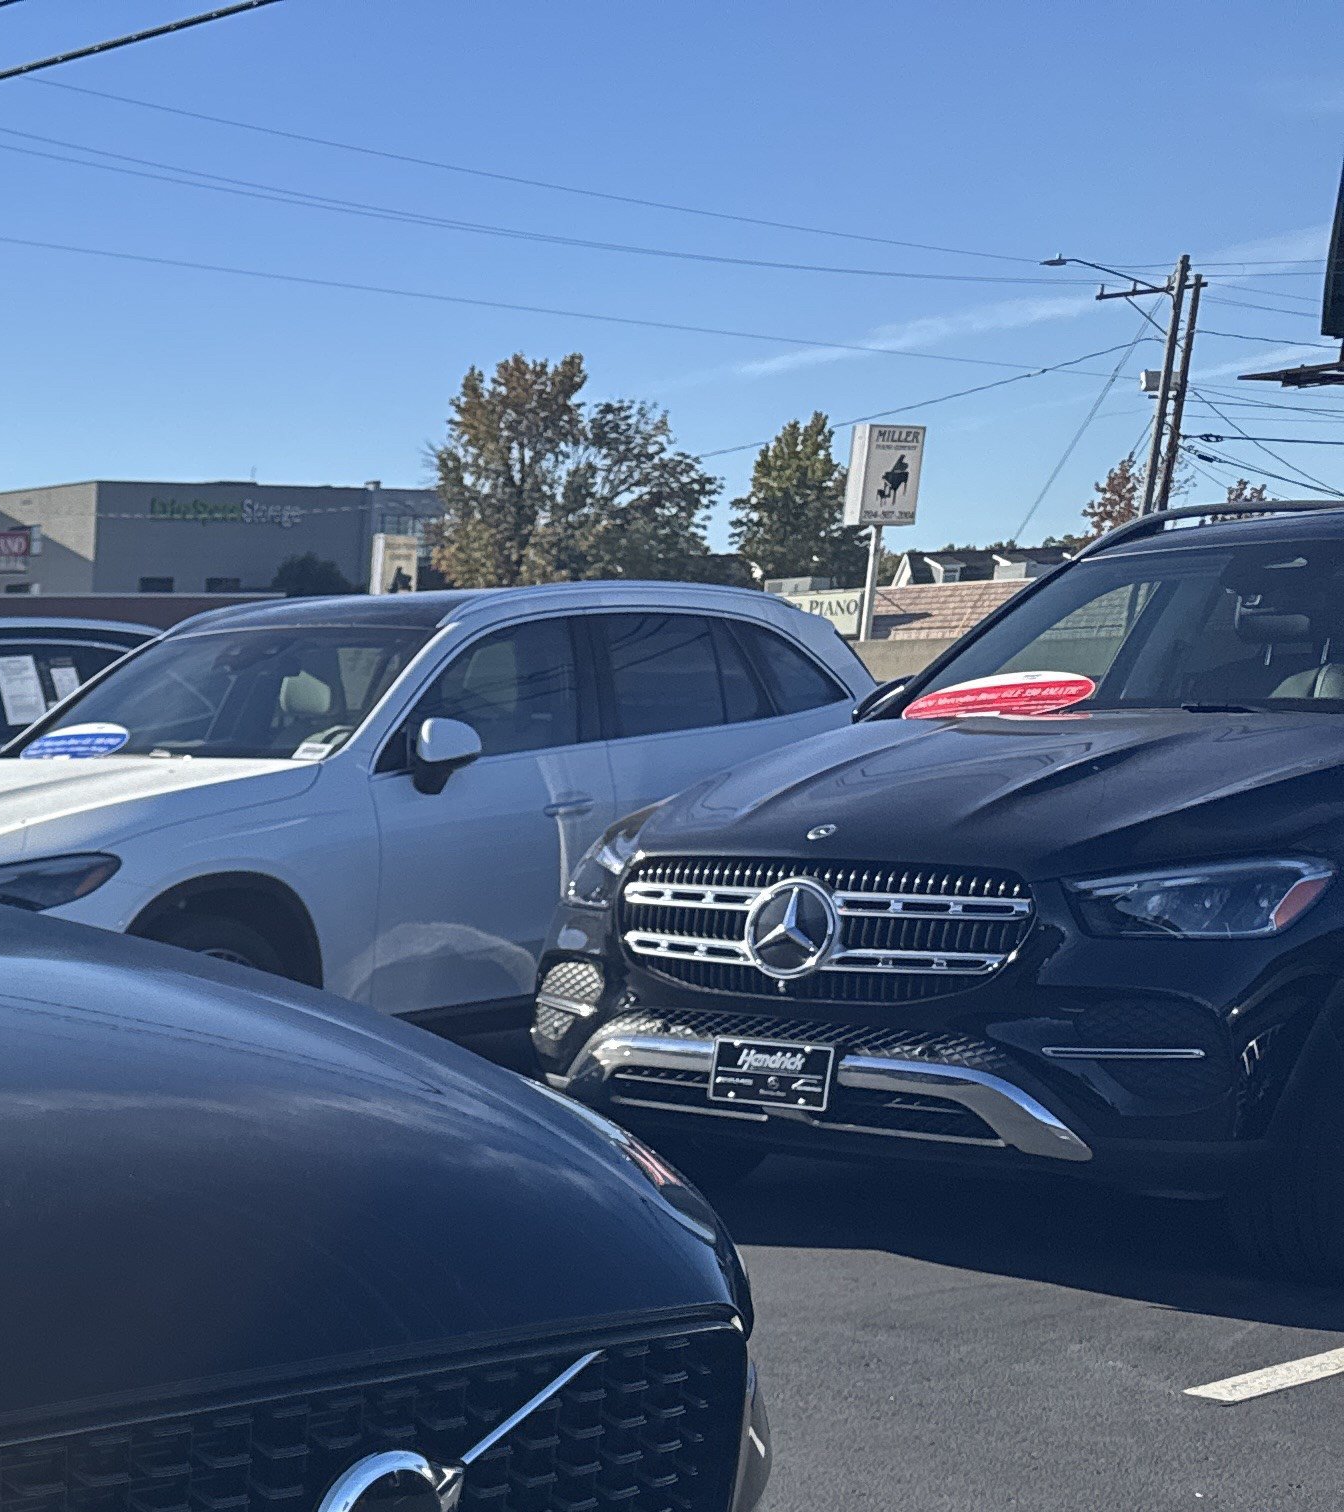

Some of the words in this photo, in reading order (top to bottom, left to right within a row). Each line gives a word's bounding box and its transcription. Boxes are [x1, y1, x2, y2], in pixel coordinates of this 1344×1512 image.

[875, 429, 921, 444] MILLER
[809, 599, 859, 617] PIANO
[736, 1047, 806, 1071] Hendrick
